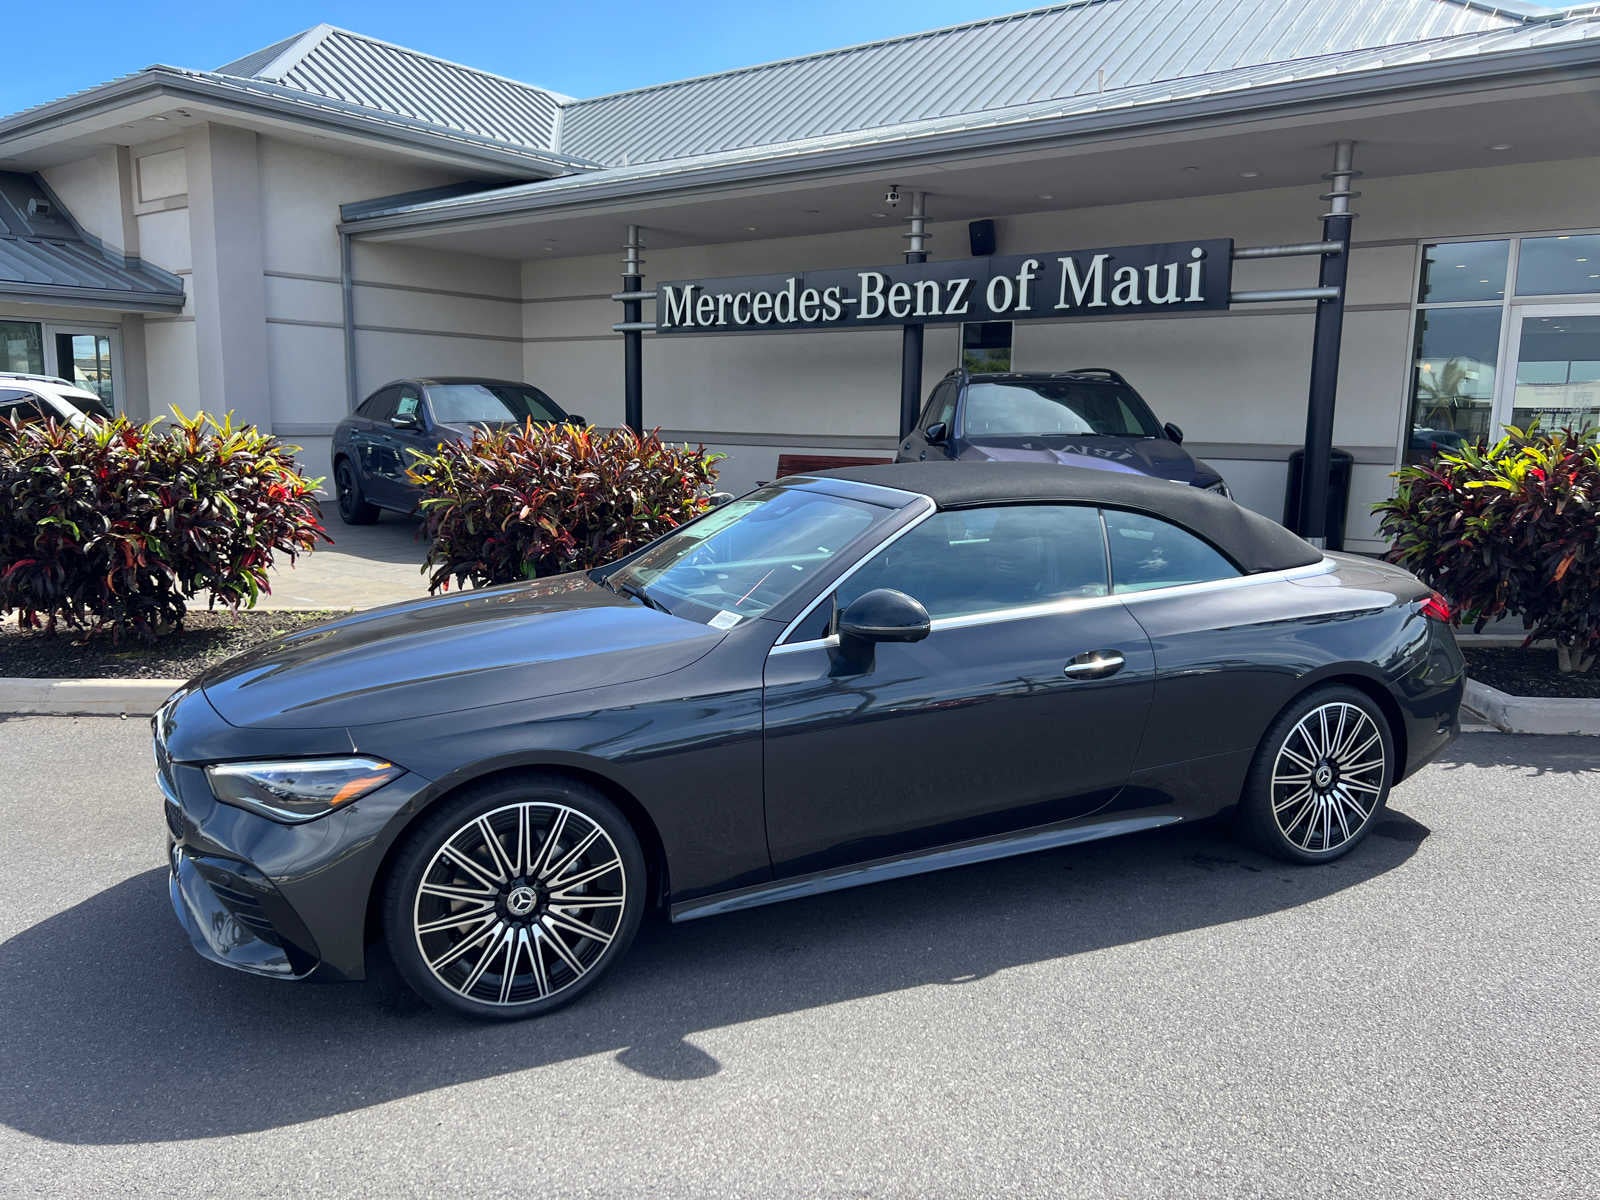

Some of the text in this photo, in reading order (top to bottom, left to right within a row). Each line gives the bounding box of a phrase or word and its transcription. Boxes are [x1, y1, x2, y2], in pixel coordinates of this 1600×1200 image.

[662, 247, 1206, 327] Mercedes-Benz of Maui
